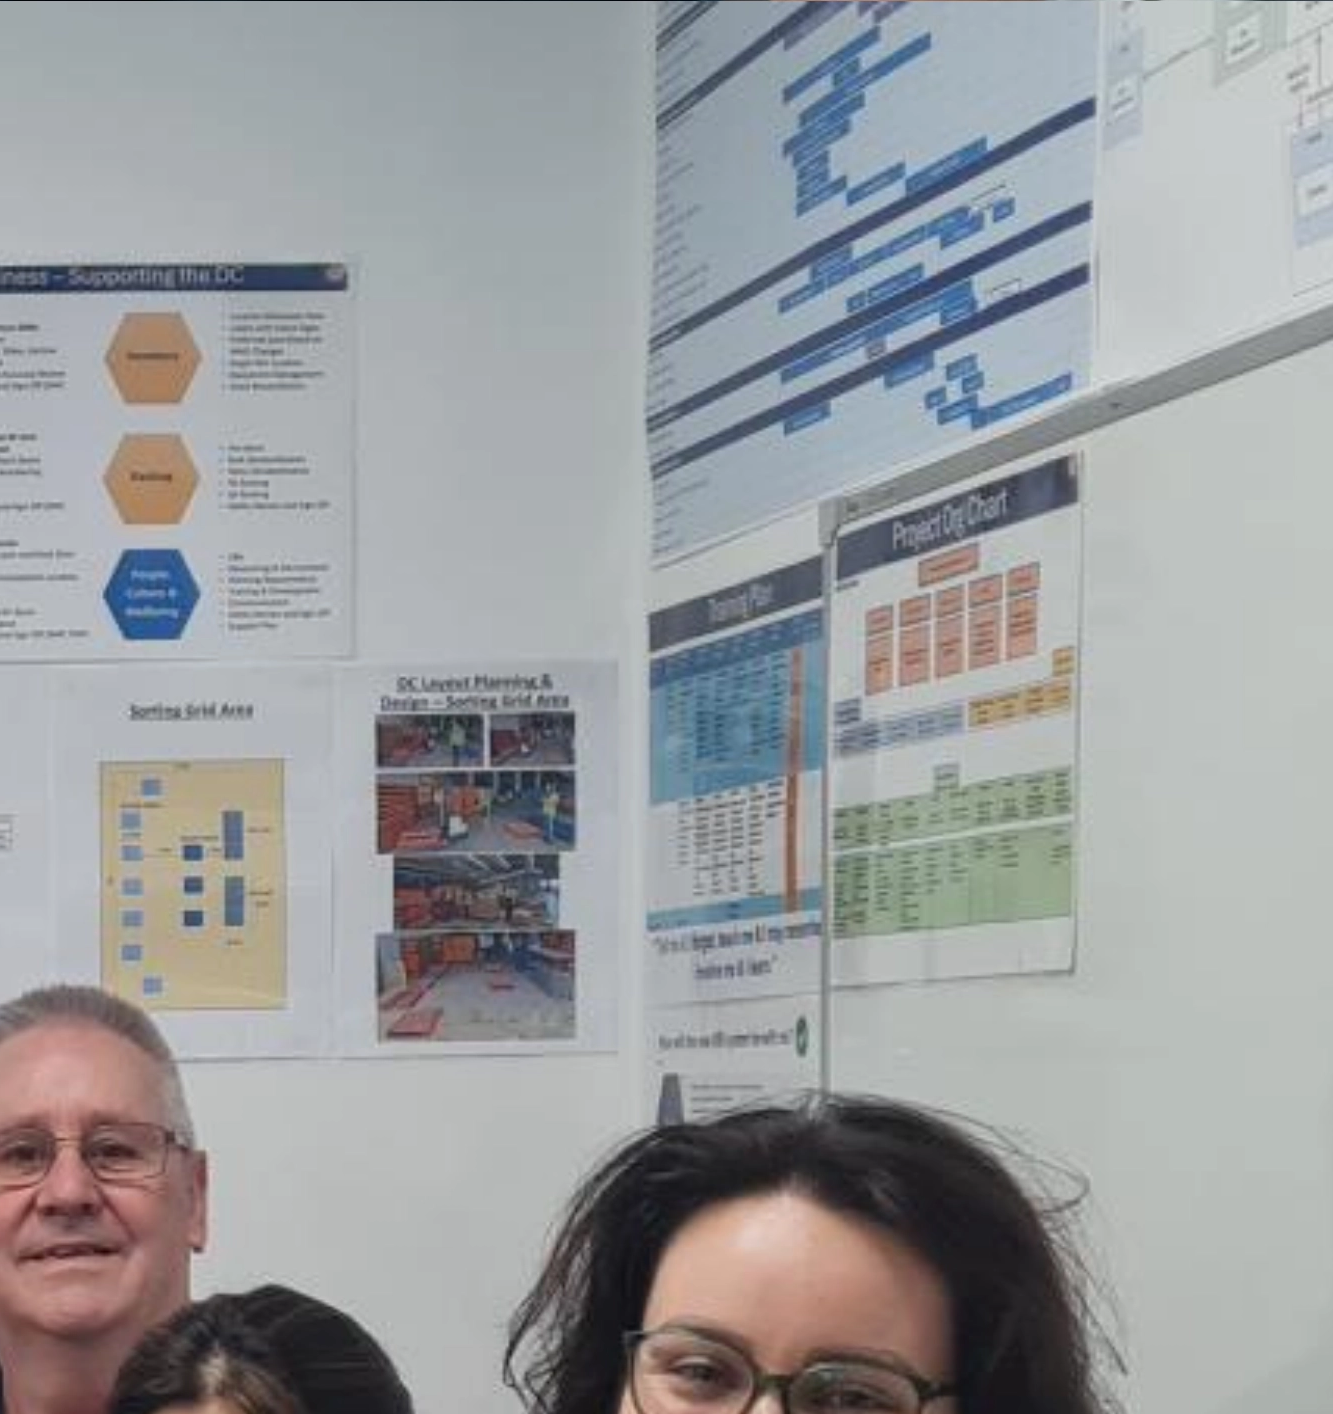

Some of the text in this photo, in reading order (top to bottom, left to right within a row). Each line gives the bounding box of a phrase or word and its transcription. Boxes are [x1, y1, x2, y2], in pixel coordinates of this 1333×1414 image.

[68, 266, 174, 289] Supporting
[179, 264, 211, 285] the
[216, 264, 245, 283] DC
[892, 488, 1008, 552] Project Org Chart
[130, 701, 253, 721] Sorting Grid Area
[380, 692, 569, 713] Design Sorting Grid Area
